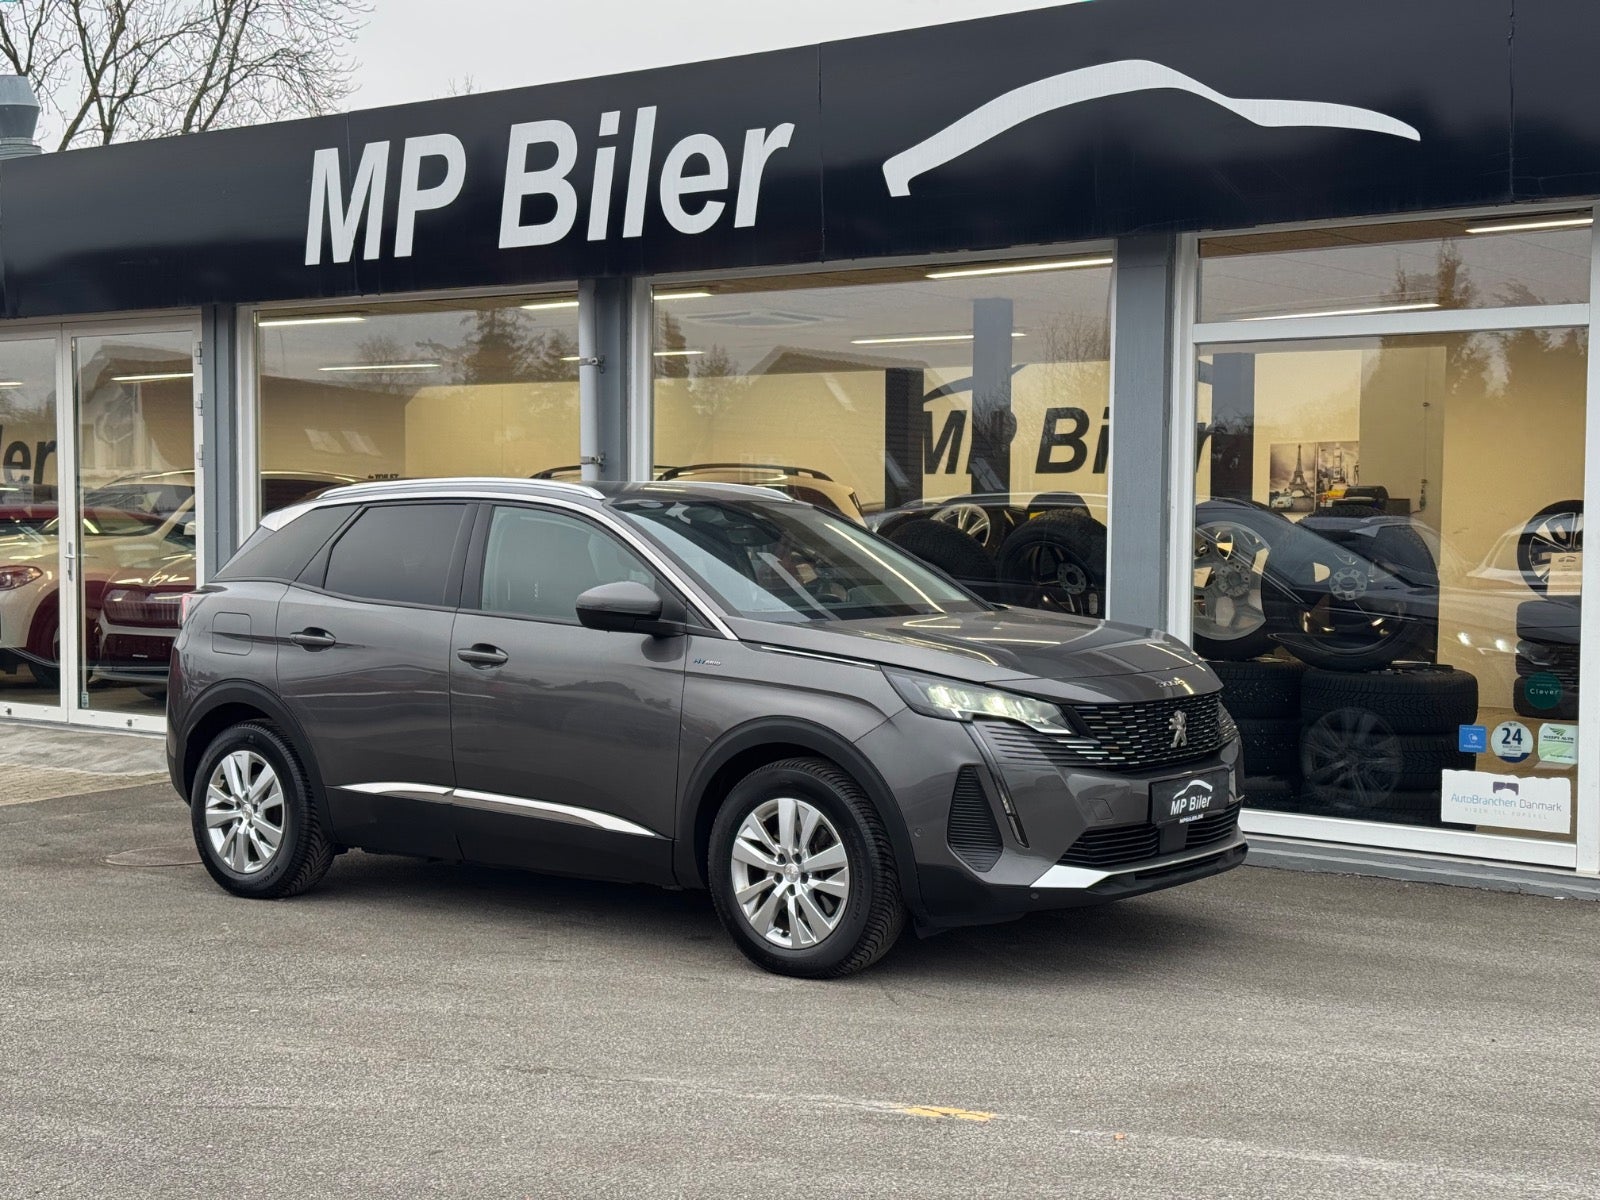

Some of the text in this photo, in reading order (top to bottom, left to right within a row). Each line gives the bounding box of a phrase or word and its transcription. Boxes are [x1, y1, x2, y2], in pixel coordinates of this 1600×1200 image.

[304, 105, 796, 267] MP Biler
[1529, 688, 1560, 696] Clever
[1501, 727, 1523, 746] 24
[1170, 794, 1213, 815] MP Biler
[1450, 793, 1562, 812] AutoBranchen Danmark
